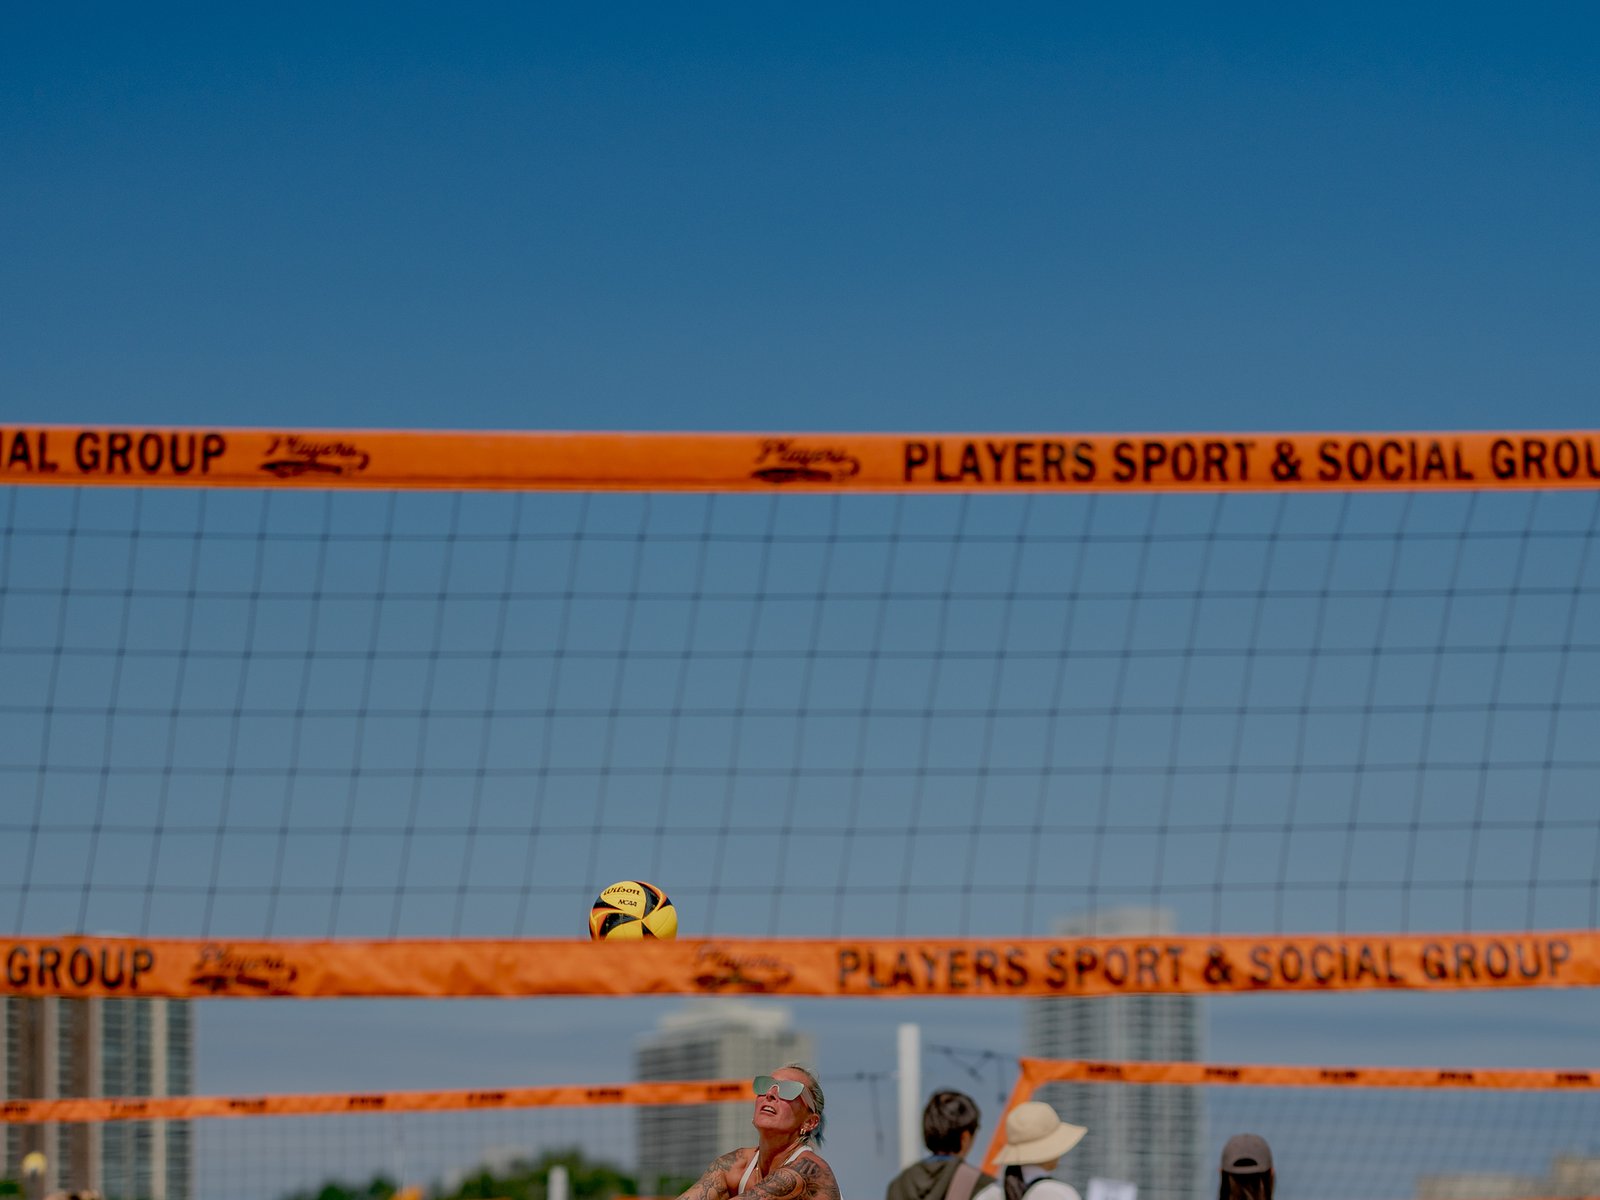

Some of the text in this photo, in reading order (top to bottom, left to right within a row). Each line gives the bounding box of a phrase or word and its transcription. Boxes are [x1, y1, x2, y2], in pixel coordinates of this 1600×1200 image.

[75, 432, 226, 475] GROUP
[904, 441, 1097, 484] PLAYERS
[1112, 440, 1256, 483] SPORT
[1270, 440, 1303, 483] &
[1317, 440, 1474, 482] SOCIAL
[6, 946, 154, 988] GROUP
[838, 939, 1573, 989] PLAYERS SPORT & SOCIAL GROUP
